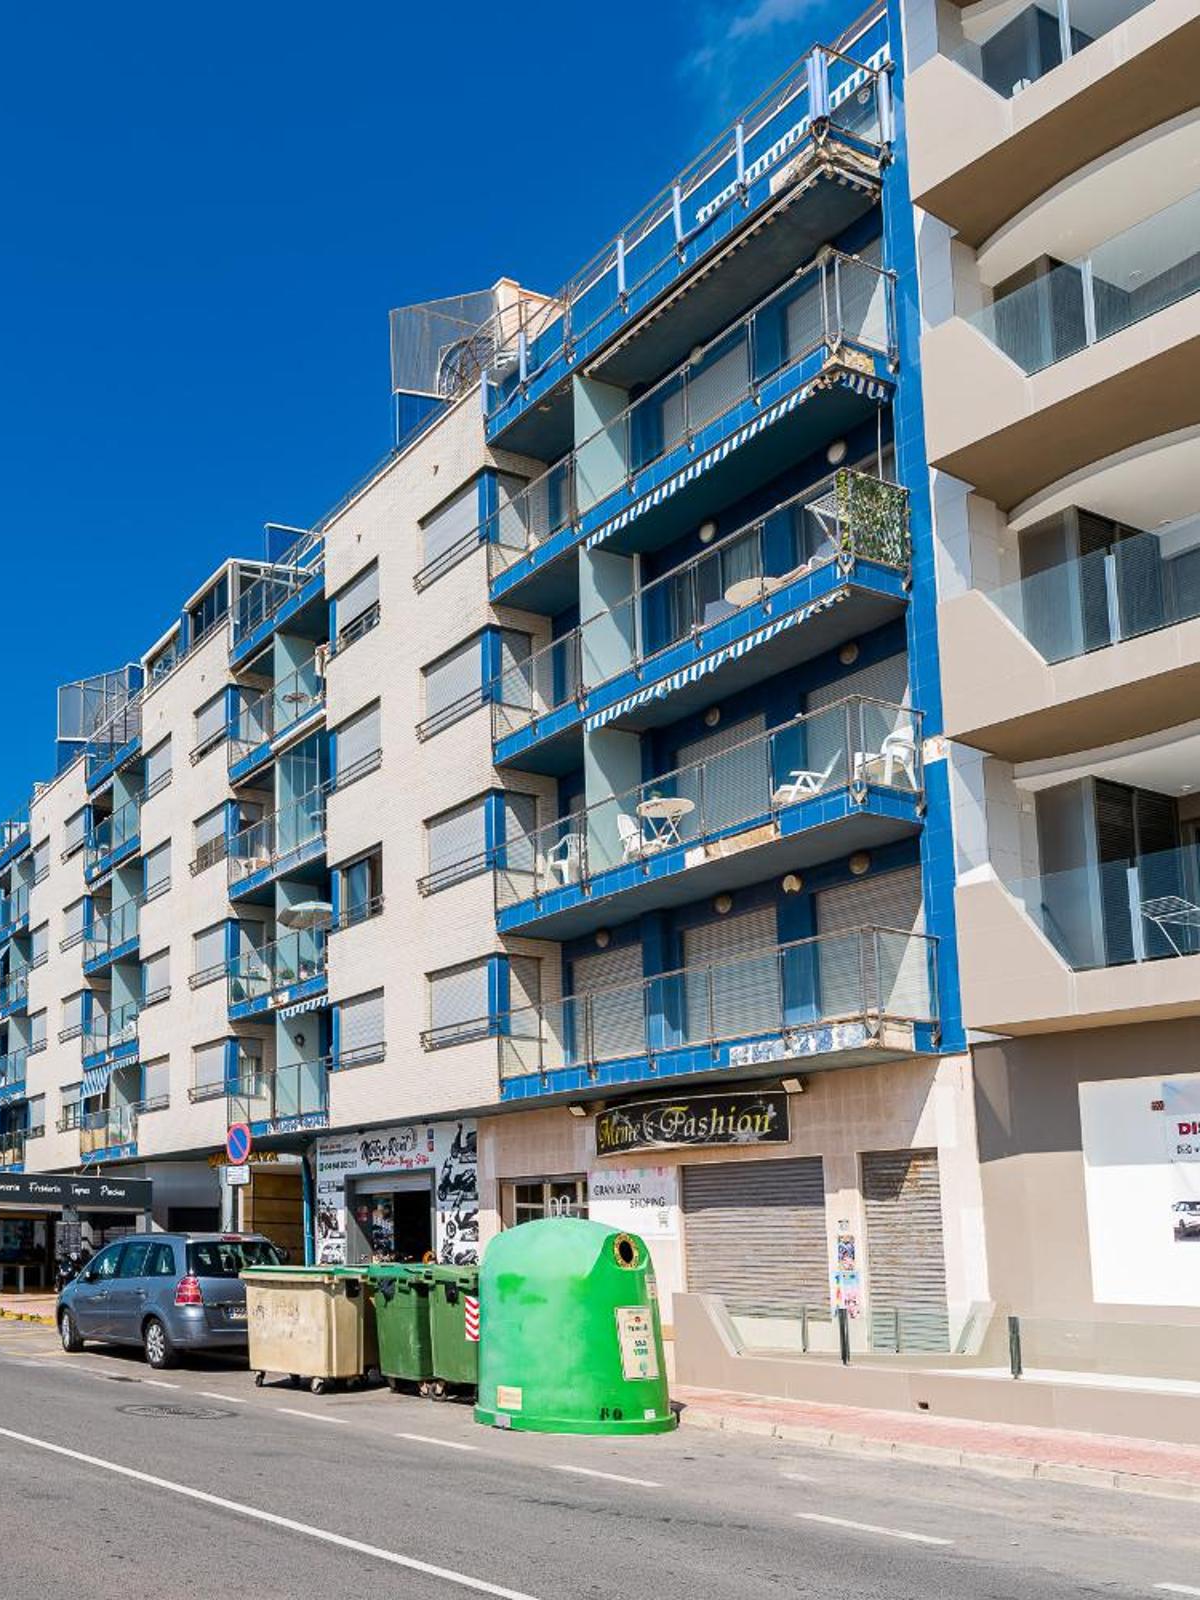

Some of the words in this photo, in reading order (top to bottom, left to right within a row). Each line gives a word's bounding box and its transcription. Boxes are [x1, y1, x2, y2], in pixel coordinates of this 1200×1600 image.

[660, 1105, 772, 1138] Fashion
[593, 1184, 615, 1196] GRAN
[616, 1183, 641, 1195] BAZAR
